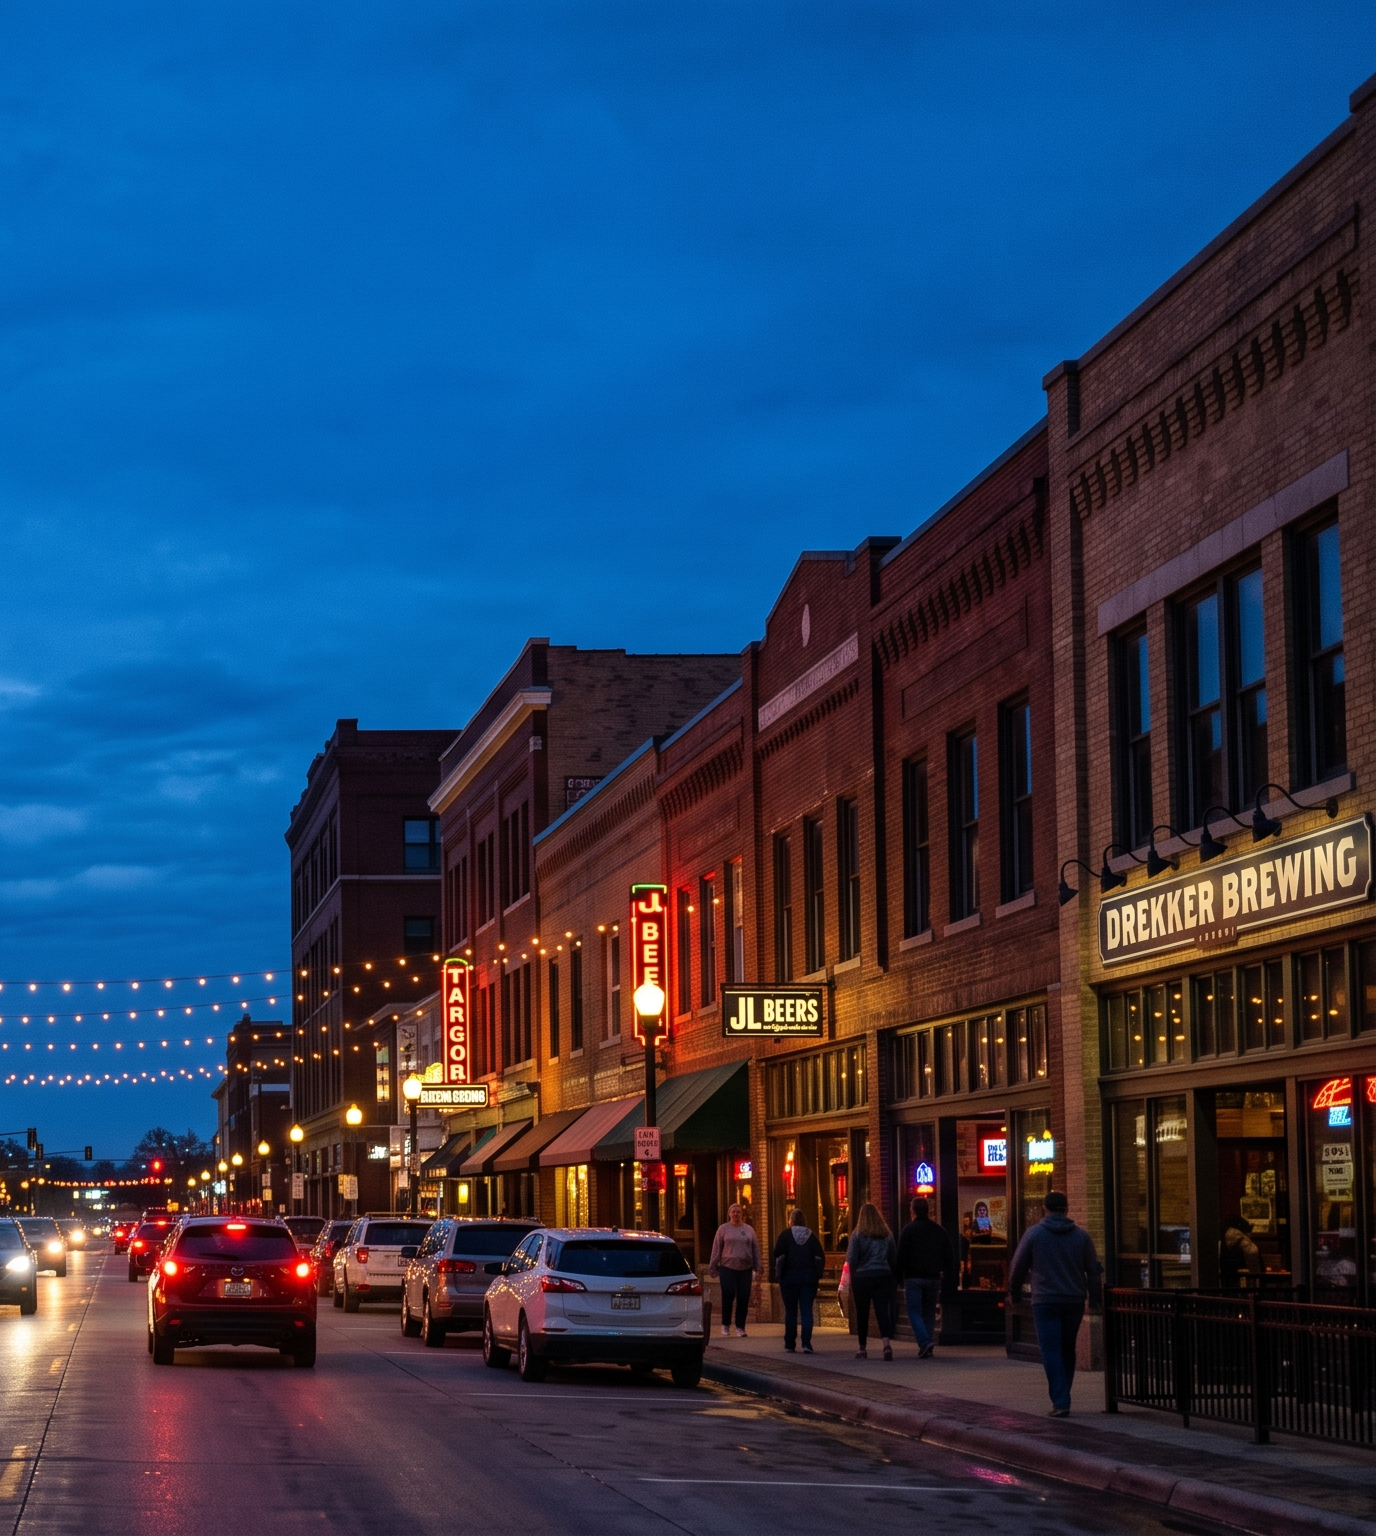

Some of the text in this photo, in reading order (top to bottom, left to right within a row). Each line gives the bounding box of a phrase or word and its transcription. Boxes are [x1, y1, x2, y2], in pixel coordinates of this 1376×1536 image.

[1106, 835, 1357, 951] DREKKER BREWING
[730, 997, 819, 1030] JL BEERS
